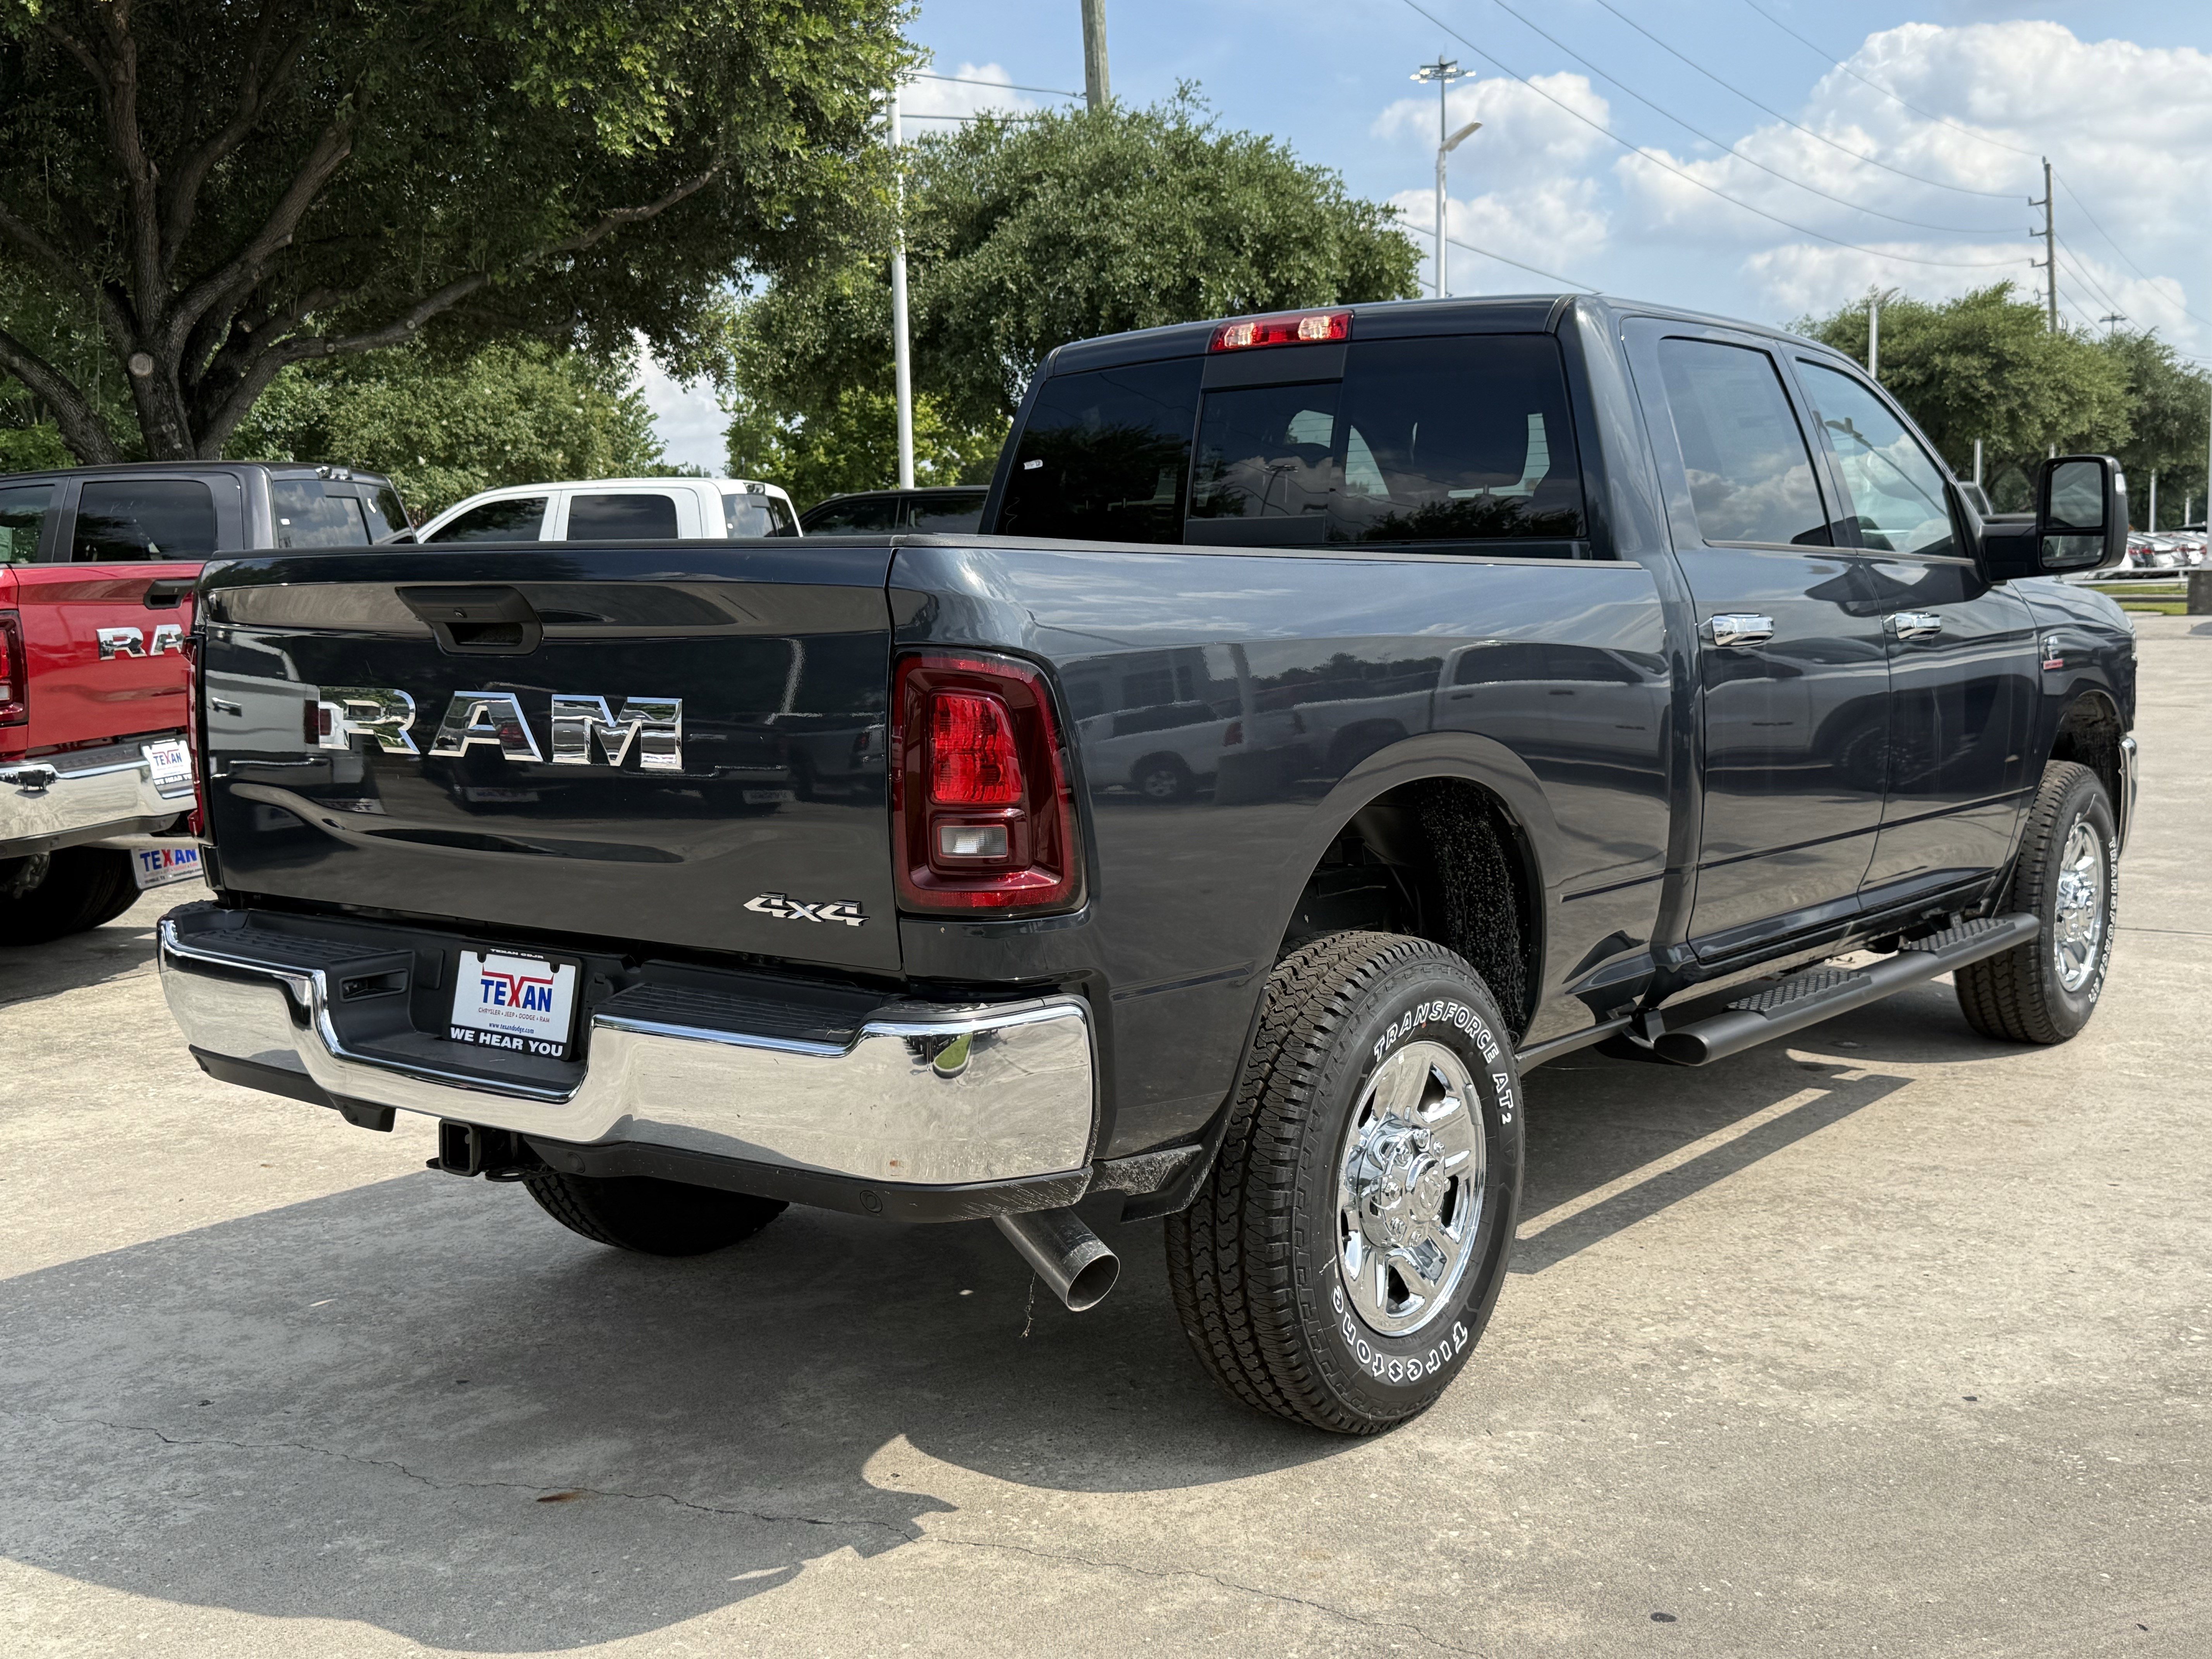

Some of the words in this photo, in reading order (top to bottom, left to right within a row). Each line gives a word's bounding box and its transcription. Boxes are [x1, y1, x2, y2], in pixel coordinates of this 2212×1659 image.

[319, 685, 684, 769] RAM
[152, 749, 182, 766] TEXAN
[140, 849, 197, 872] TEXAN
[481, 968, 554, 1012] TEXAN
[478, 1007, 501, 1016] CHRYSLER
[450, 1027, 475, 1042] WE
[479, 1032, 524, 1050] HEAR
[529, 1041, 563, 1057] YOU
[1373, 1001, 1499, 1064] TRANSFORCE
[1333, 1285, 1468, 1382] Firestone
